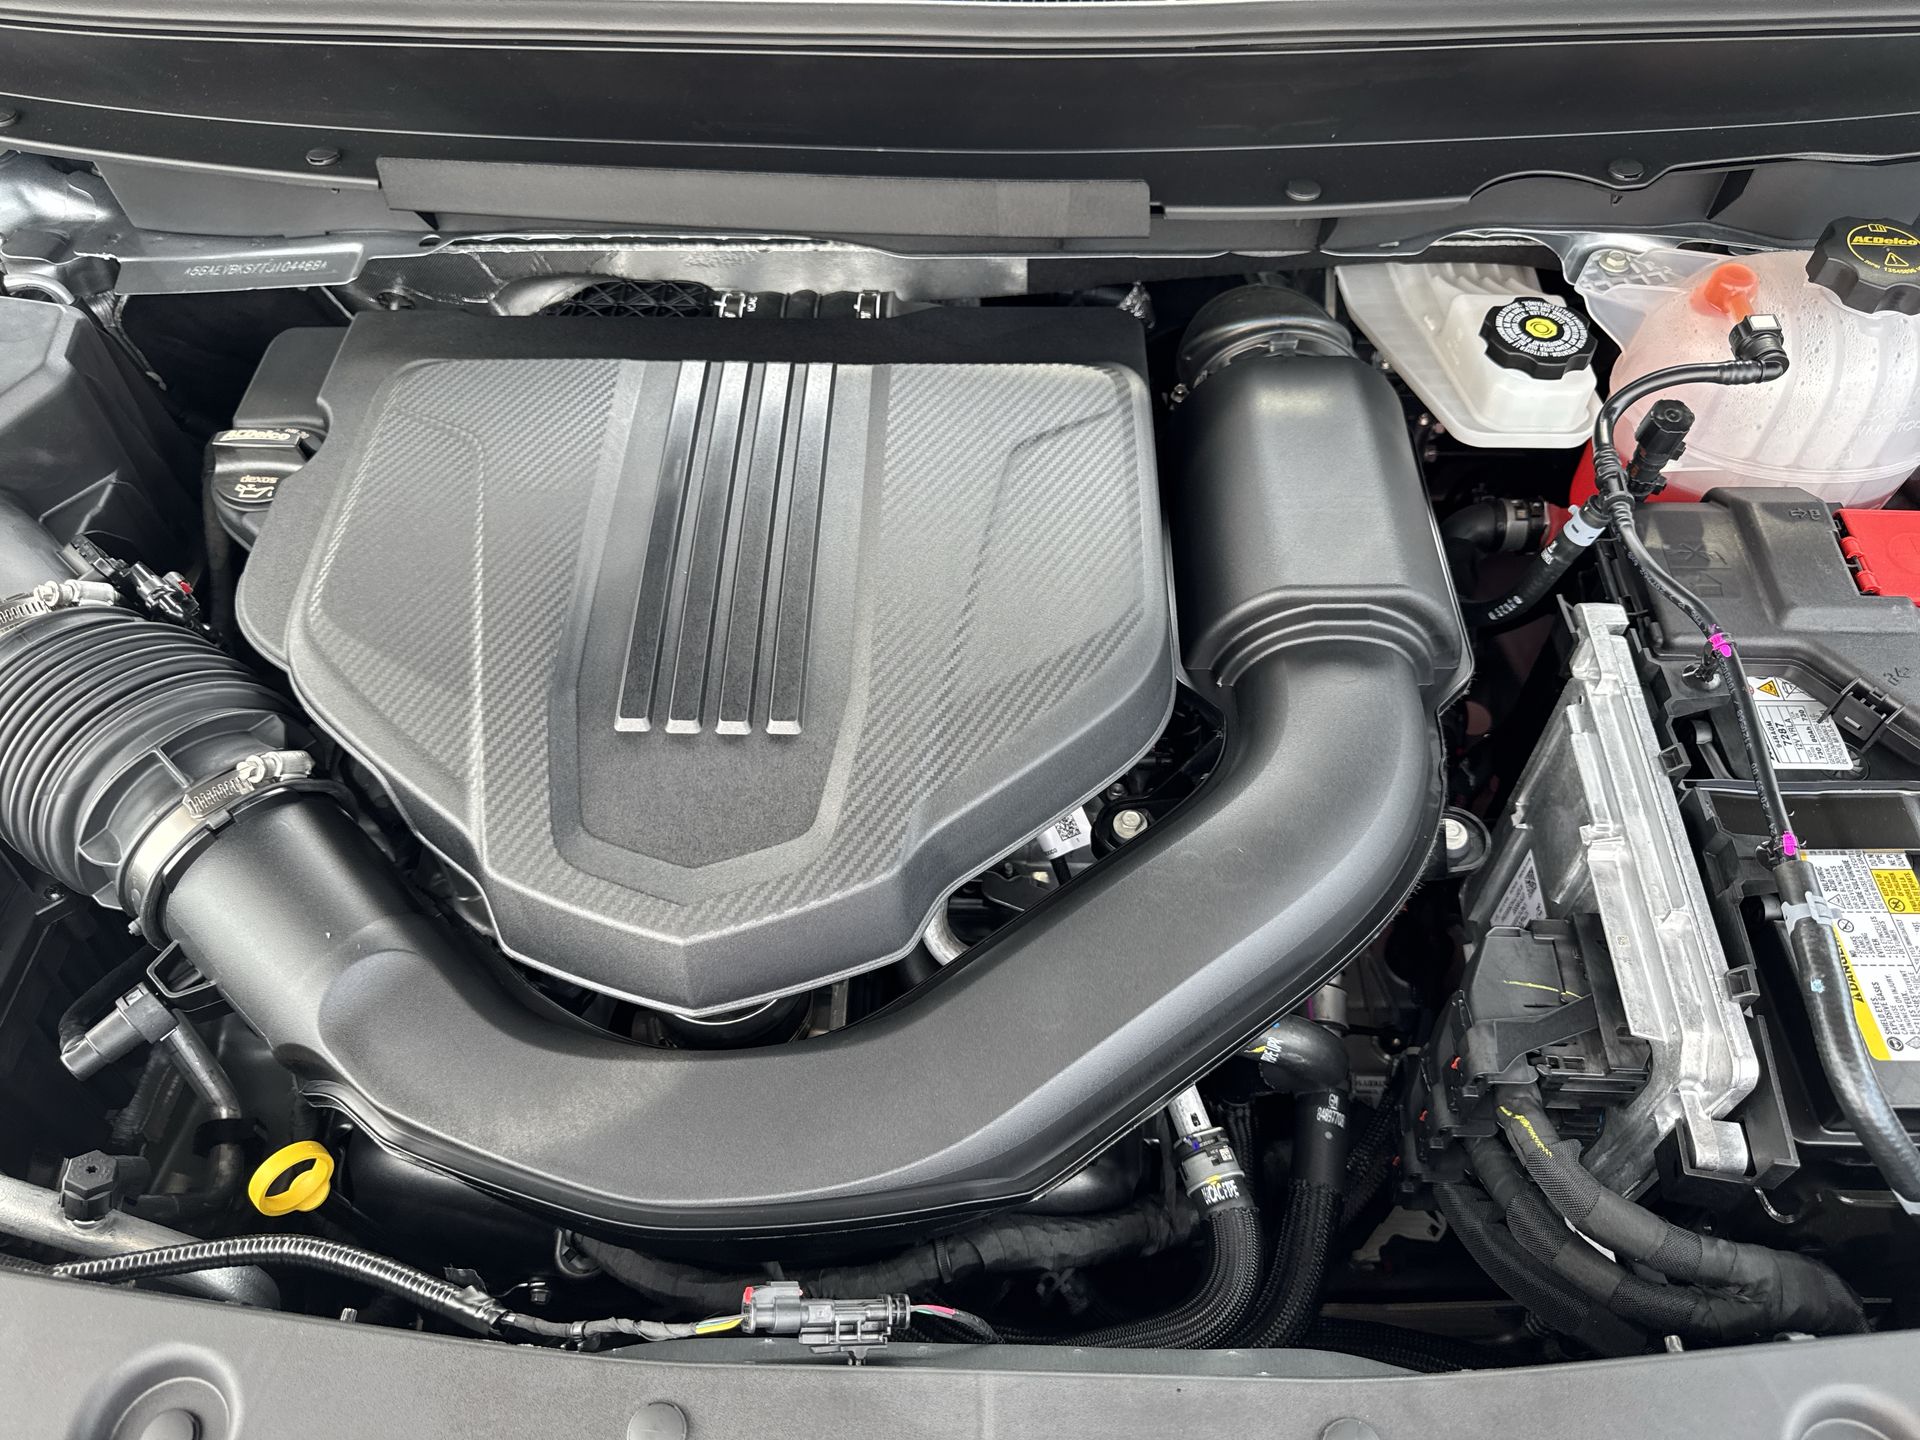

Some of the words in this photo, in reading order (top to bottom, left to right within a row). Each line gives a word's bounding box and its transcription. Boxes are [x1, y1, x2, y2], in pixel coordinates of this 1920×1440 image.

[1852, 235, 1918, 245] ACDelco
[222, 429, 291, 441] ACDelco
[240, 475, 279, 484] dexos
[1798, 709, 1808, 721] 730
[1775, 722, 1792, 745] 7287
[1784, 718, 1797, 736] VRLA
[1806, 726, 1817, 742] 80Ah
[1793, 739, 1803, 749] 12V
[1815, 747, 1825, 758] 730
[1872, 981, 1886, 1000] GASES
[1878, 1013, 1892, 1034] SHIELD
[1881, 1001, 1901, 1034] EXPLOSIVE
